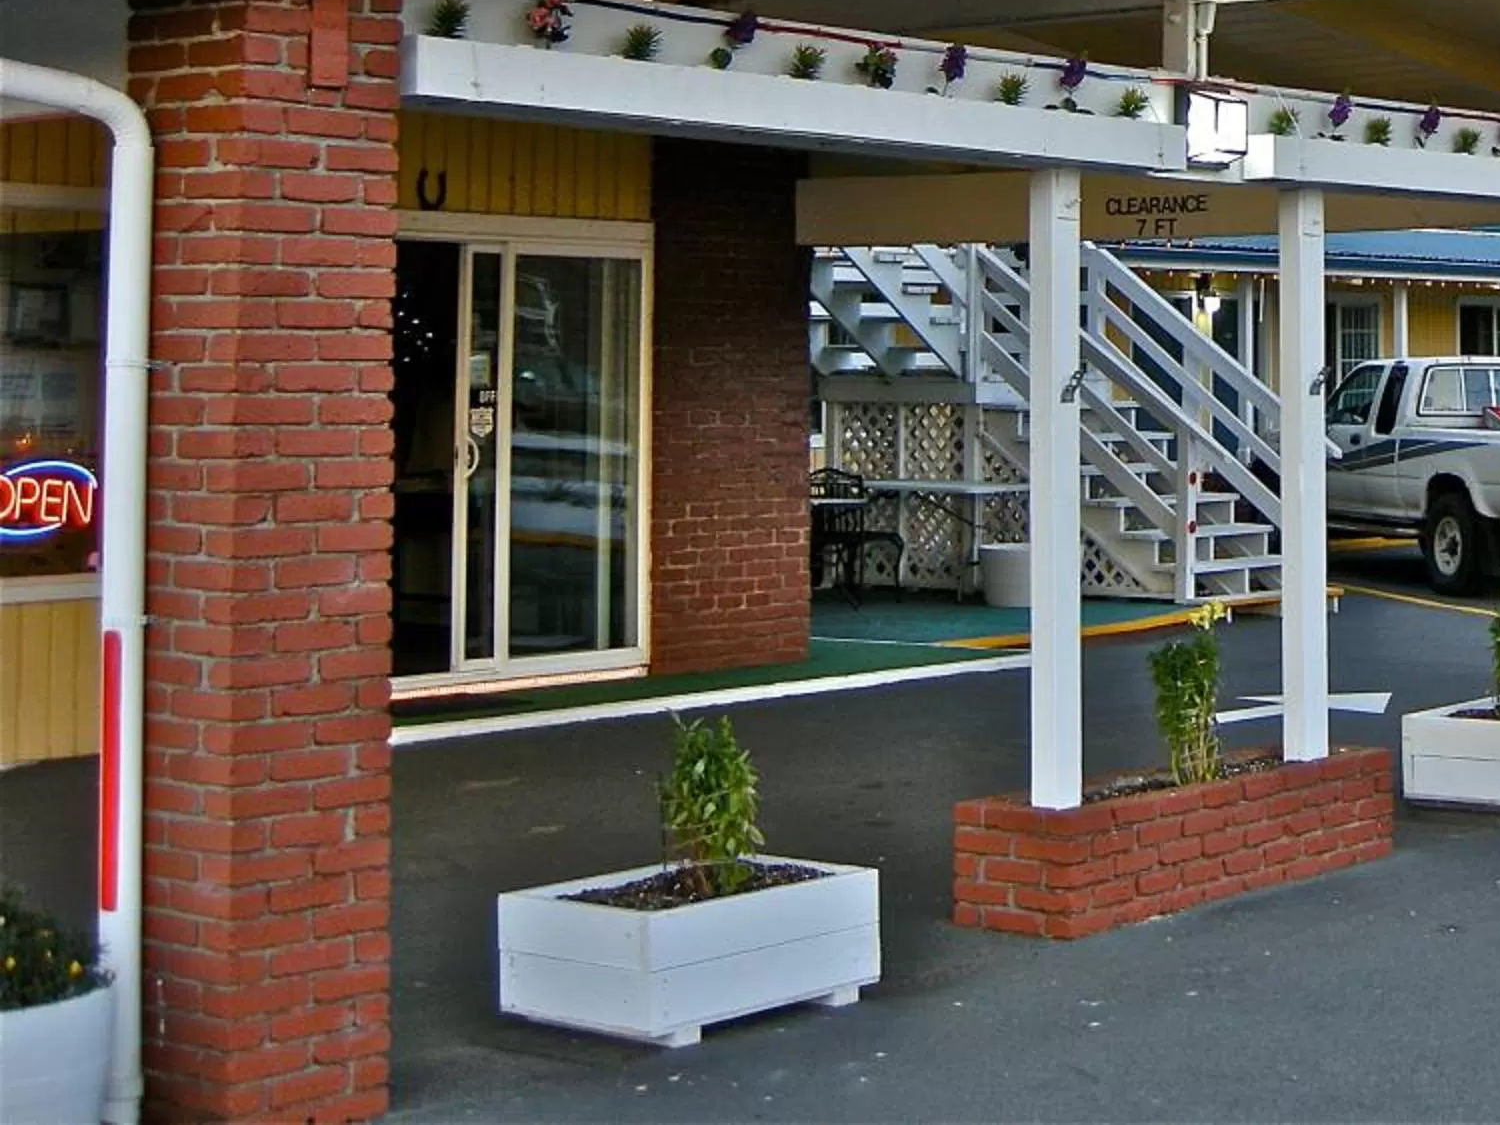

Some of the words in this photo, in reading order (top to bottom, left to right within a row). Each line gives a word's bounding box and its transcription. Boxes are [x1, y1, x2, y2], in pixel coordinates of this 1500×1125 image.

[1105, 194, 1209, 216] CLEARANCE
[1136, 218, 1147, 236] 7
[1155, 218, 1178, 236] FT
